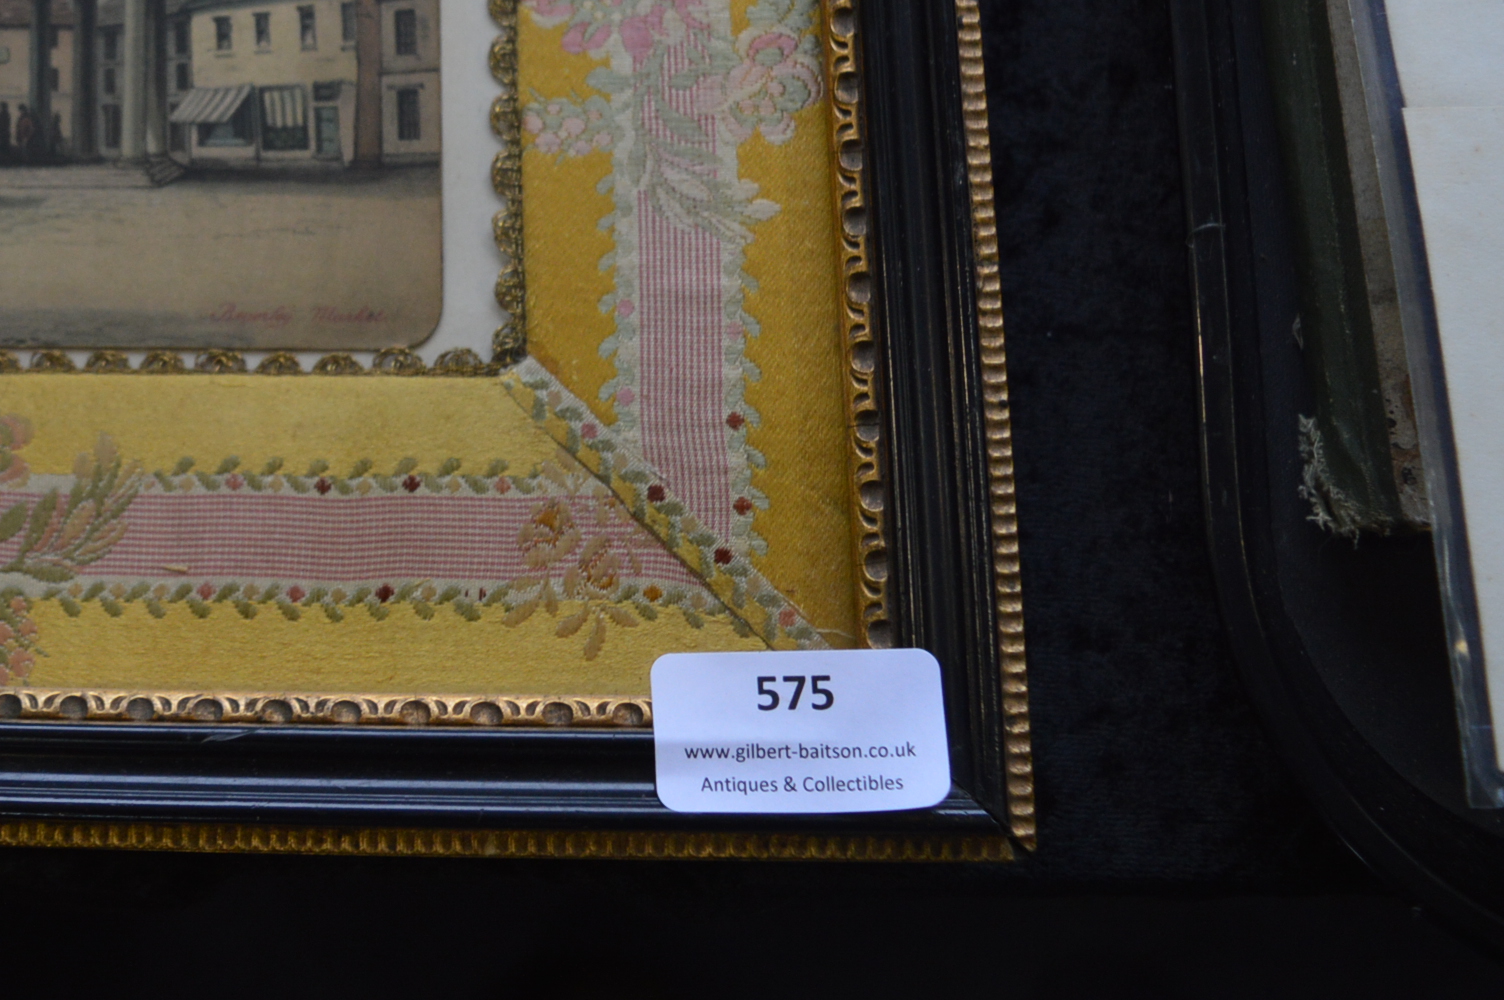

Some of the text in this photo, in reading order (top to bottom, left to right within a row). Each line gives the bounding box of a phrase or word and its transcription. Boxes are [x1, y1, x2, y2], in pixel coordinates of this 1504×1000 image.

[756, 674, 835, 711] 575
[684, 741, 917, 763] www.gilbert-baitson.co.uk
[701, 774, 904, 795] Antiques & Collectibles
